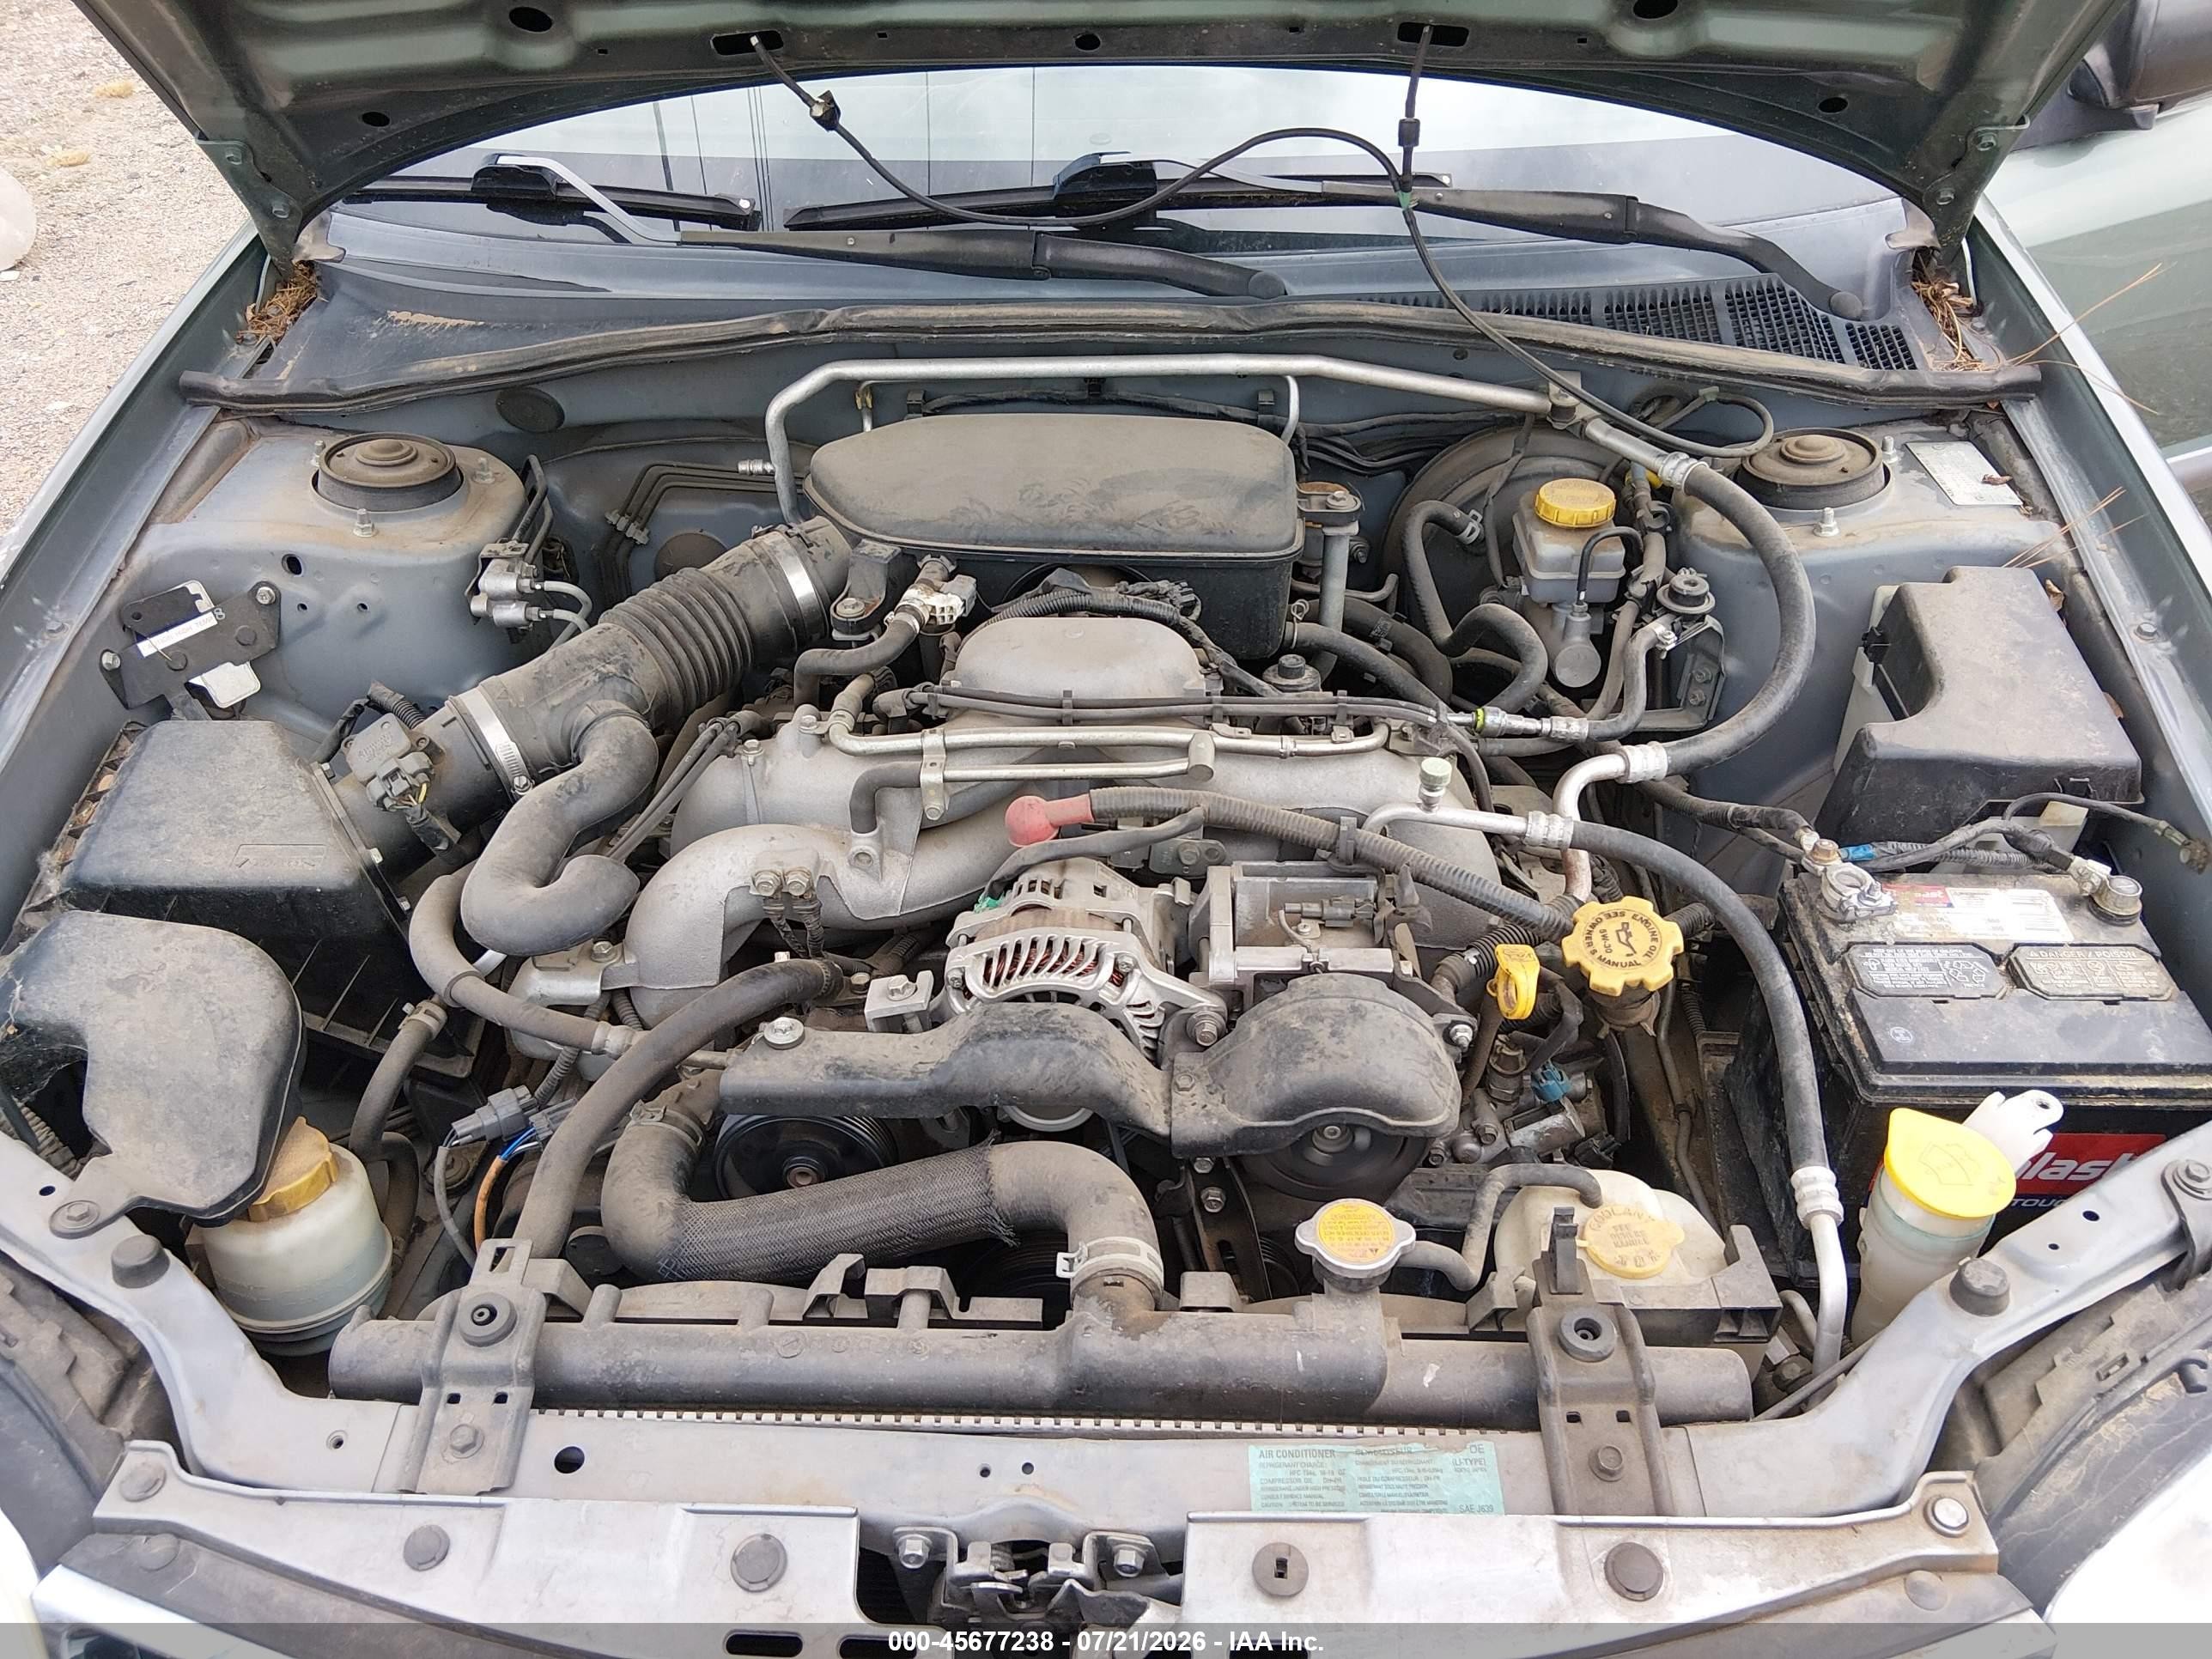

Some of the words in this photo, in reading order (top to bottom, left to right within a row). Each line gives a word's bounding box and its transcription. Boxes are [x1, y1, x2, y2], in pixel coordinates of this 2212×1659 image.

[1603, 911, 1626, 920] SEE
[1632, 913, 1659, 943] ENGINE
[1642, 945, 1657, 958] OIL
[1596, 955, 1642, 968] MANUAL
[1589, 1207, 1656, 1231] COOLANT
[1259, 1449, 1274, 1459] AIR
[1276, 1449, 1336, 1459] CONDITIONER
[1459, 1504, 1474, 1513] SAE
[1477, 1504, 1494, 1513] J639
